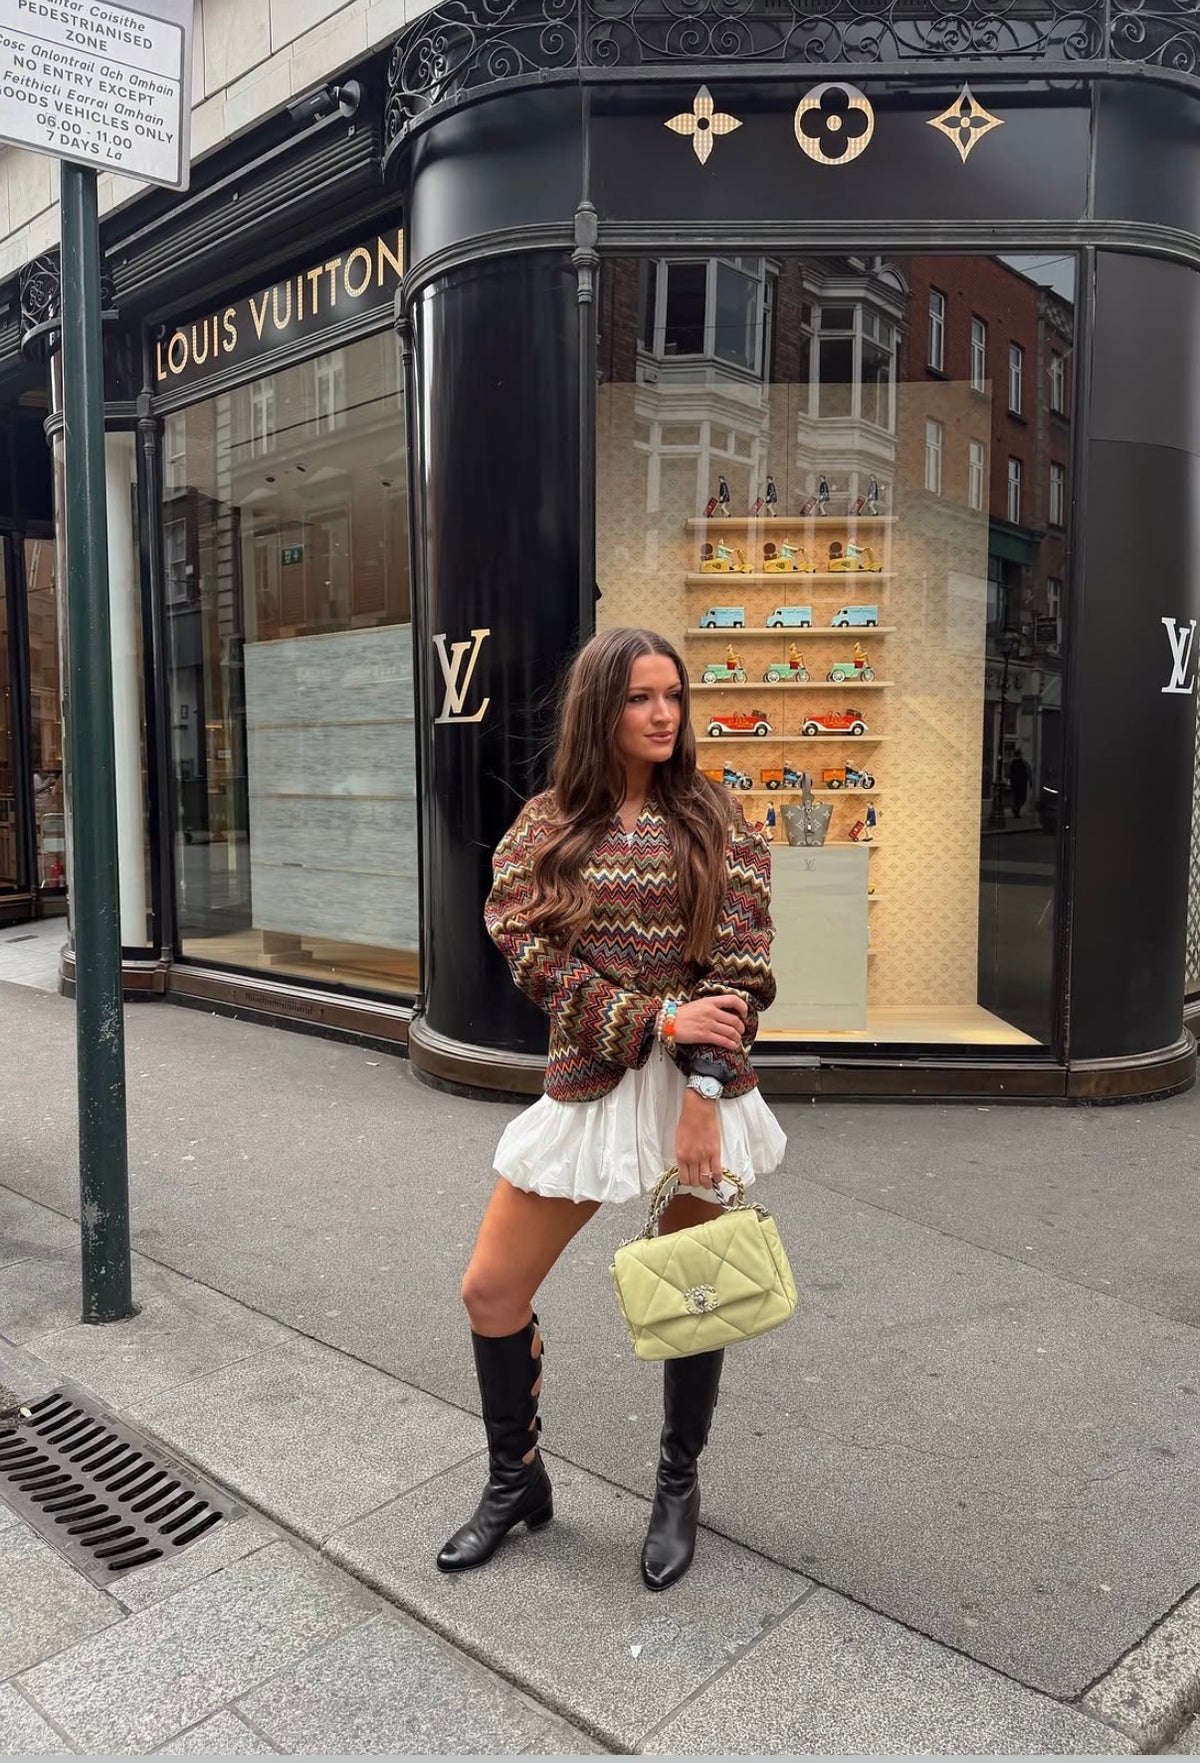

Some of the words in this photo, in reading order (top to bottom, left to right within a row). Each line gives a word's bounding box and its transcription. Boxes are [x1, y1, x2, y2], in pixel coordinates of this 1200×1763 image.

[18, 0, 153, 50] PEDESTRIANISED
[90, 6, 145, 31] Coisithe
[66, 29, 107, 52] ZONE
[13, 54, 37, 71] NO
[43, 63, 93, 87] ENTRY
[99, 80, 155, 106] EXCEPT
[100, 65, 123, 81] Ach
[0, 85, 48, 108] OODS
[54, 99, 129, 131] VEHICLES
[135, 124, 174, 144] ONLY
[37, 113, 82, 135] 06.00
[96, 130, 132, 149] 11.00
[46, 129, 55, 141] 7
[60, 133, 100, 154] DAYS
[157, 307, 238, 382] LOUIS
[249, 228, 405, 341] VUITTON
[431, 628, 491, 724] LV
